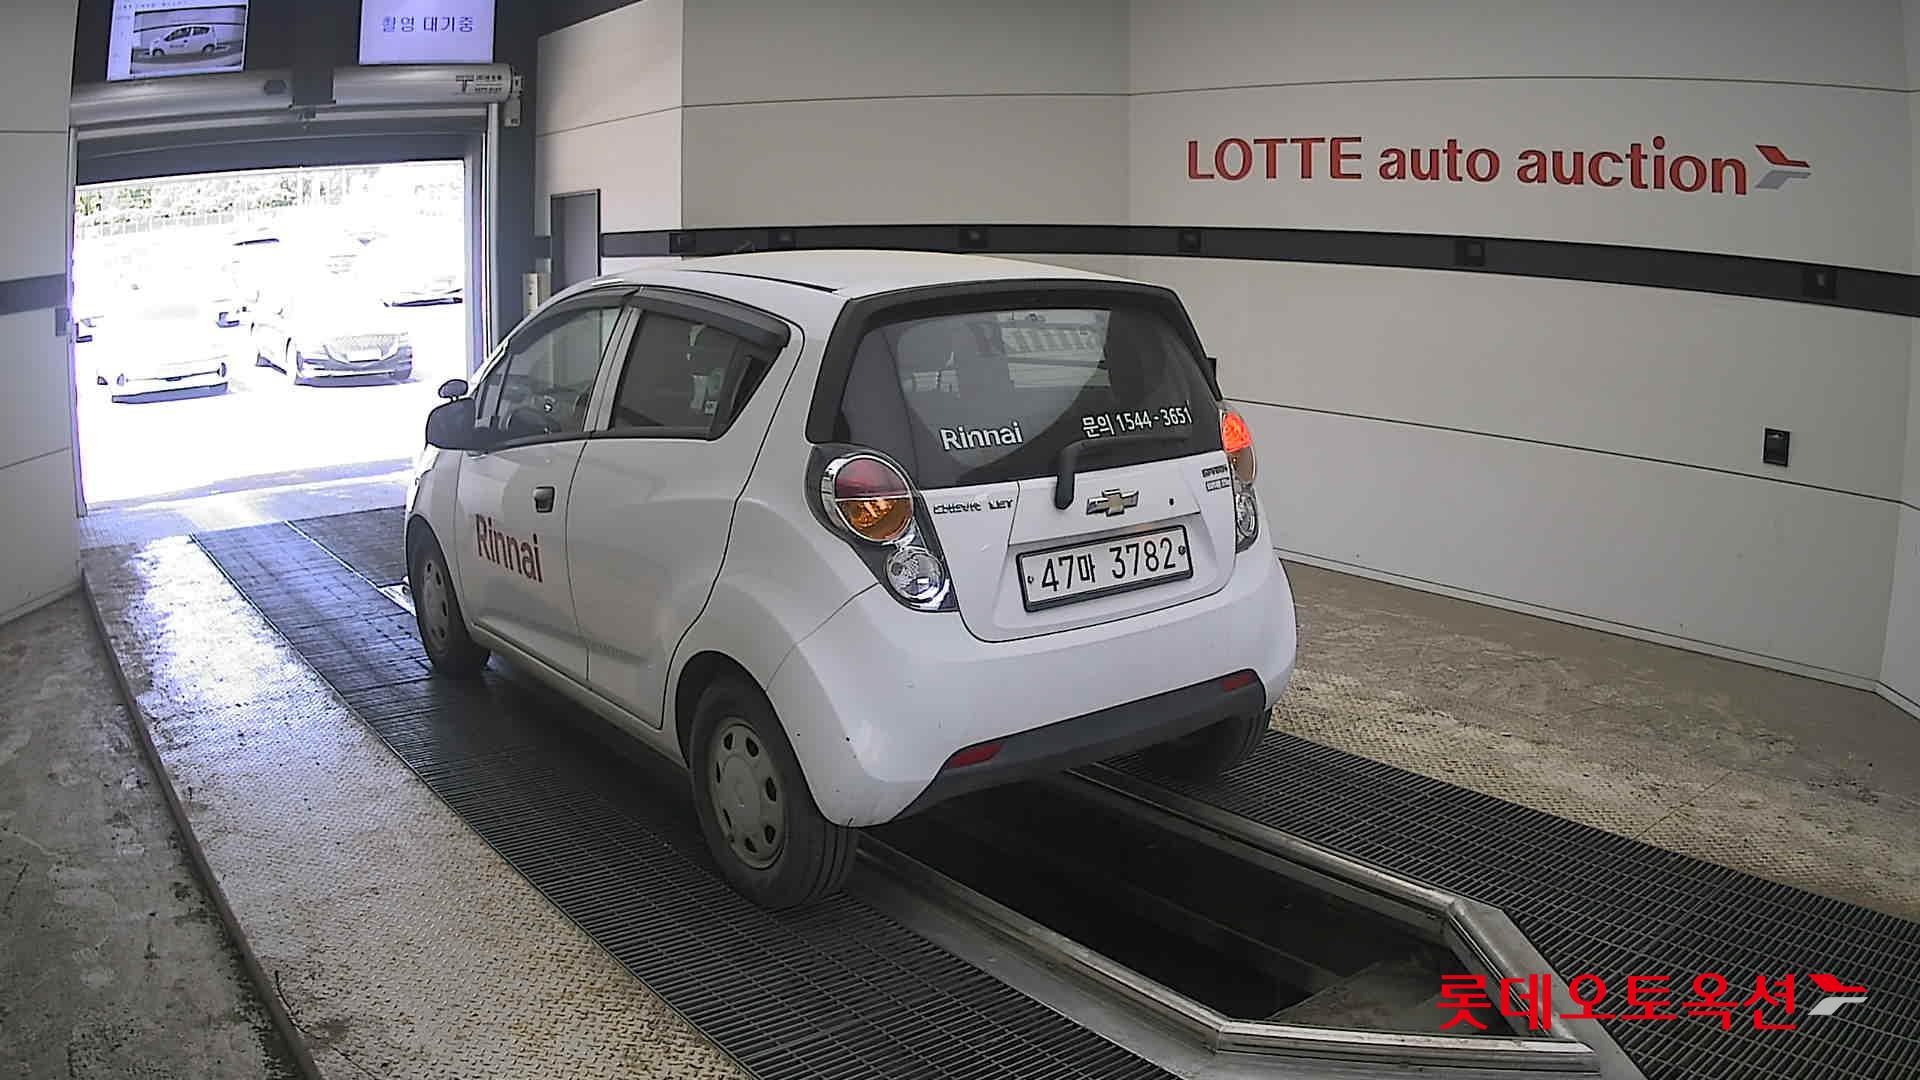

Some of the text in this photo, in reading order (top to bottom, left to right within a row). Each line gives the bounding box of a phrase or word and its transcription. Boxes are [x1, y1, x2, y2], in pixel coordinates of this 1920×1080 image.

[423, 16, 473, 32] 대기중
[1187, 136, 1748, 195] LOTTE auto auction
[940, 421, 1024, 450] Rinnai
[1082, 413, 1115, 438] 문의
[475, 513, 543, 583] Rinnai
[1040, 536, 1176, 593] 47마 3782
